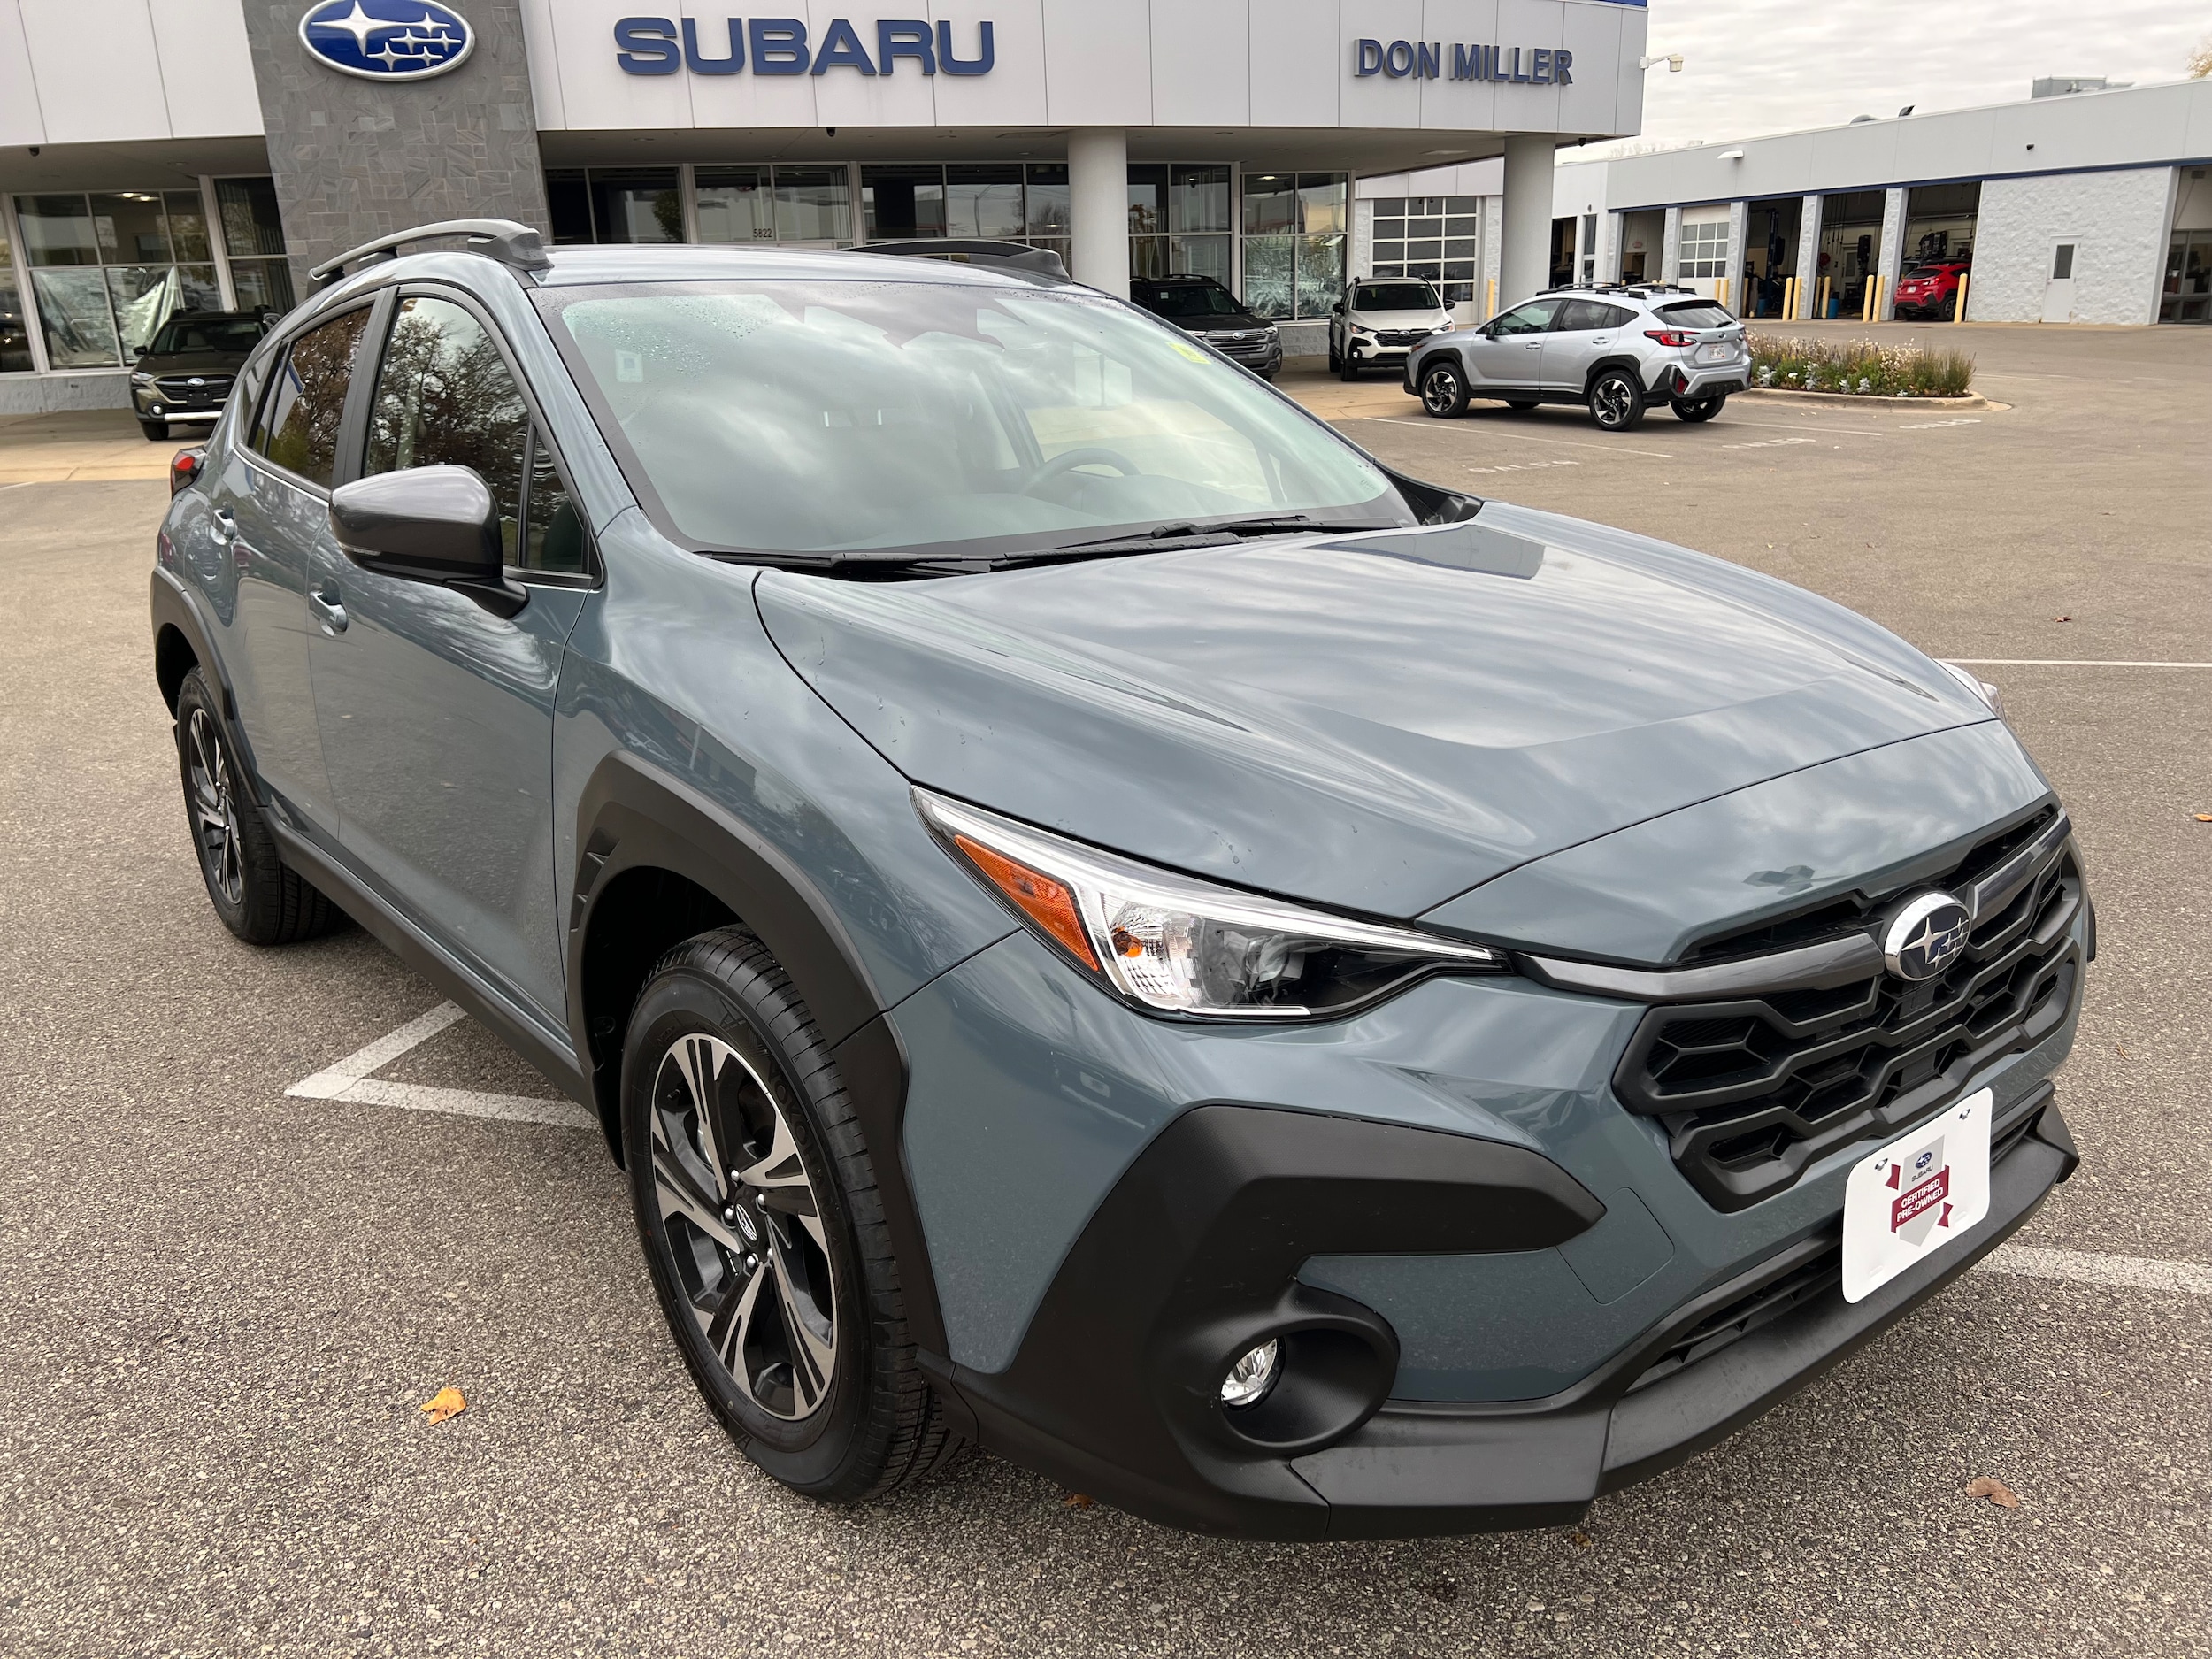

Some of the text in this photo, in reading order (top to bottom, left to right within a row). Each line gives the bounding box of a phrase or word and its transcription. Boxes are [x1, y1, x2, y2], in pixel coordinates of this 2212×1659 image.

[614, 17, 995, 75] SUBARU
[1355, 38, 1573, 85] DON MILLER
[753, 228, 772, 238] 5822
[1911, 1165, 1934, 1182] SUBARU
[1896, 1187, 1944, 1223] PRE-OWNED
[1901, 1178, 1940, 1209] CERTIFIED
